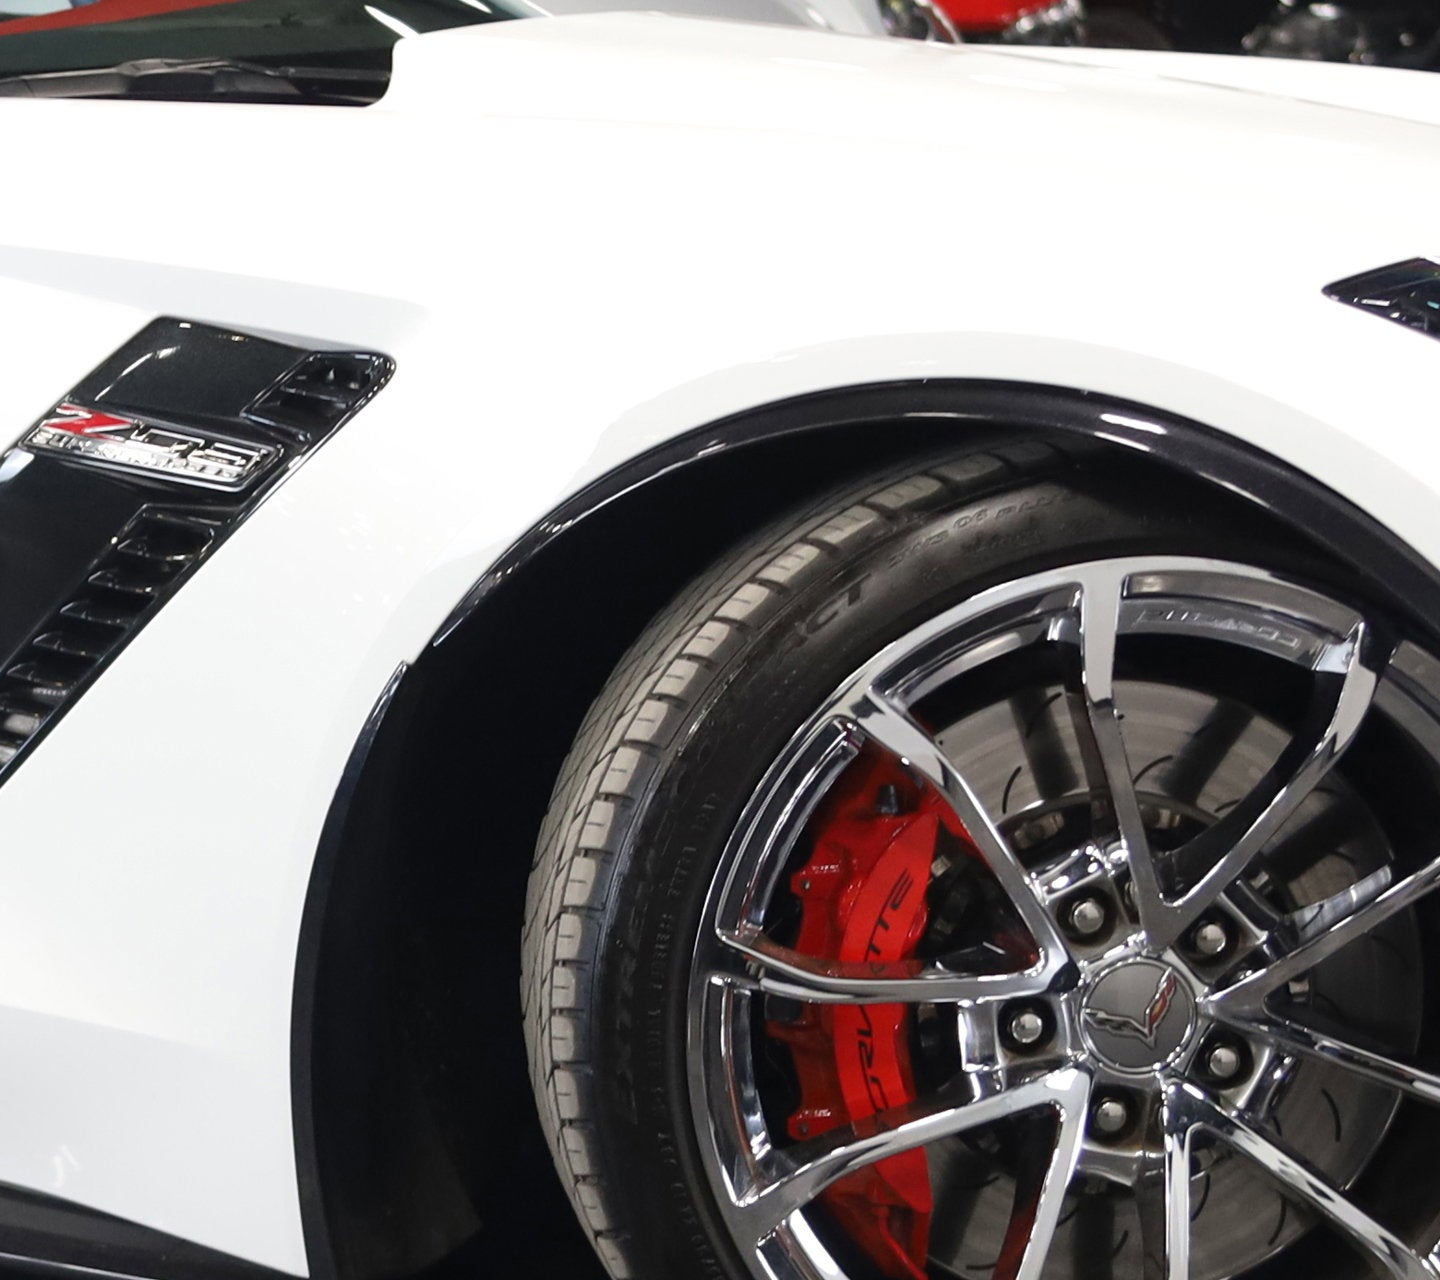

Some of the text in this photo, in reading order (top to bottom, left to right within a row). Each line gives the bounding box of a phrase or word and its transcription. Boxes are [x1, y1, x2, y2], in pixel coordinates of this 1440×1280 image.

[31, 429, 241, 481] SUPGED
[40, 402, 261, 473] Z06
[857, 868, 914, 1114] ORVTTE
